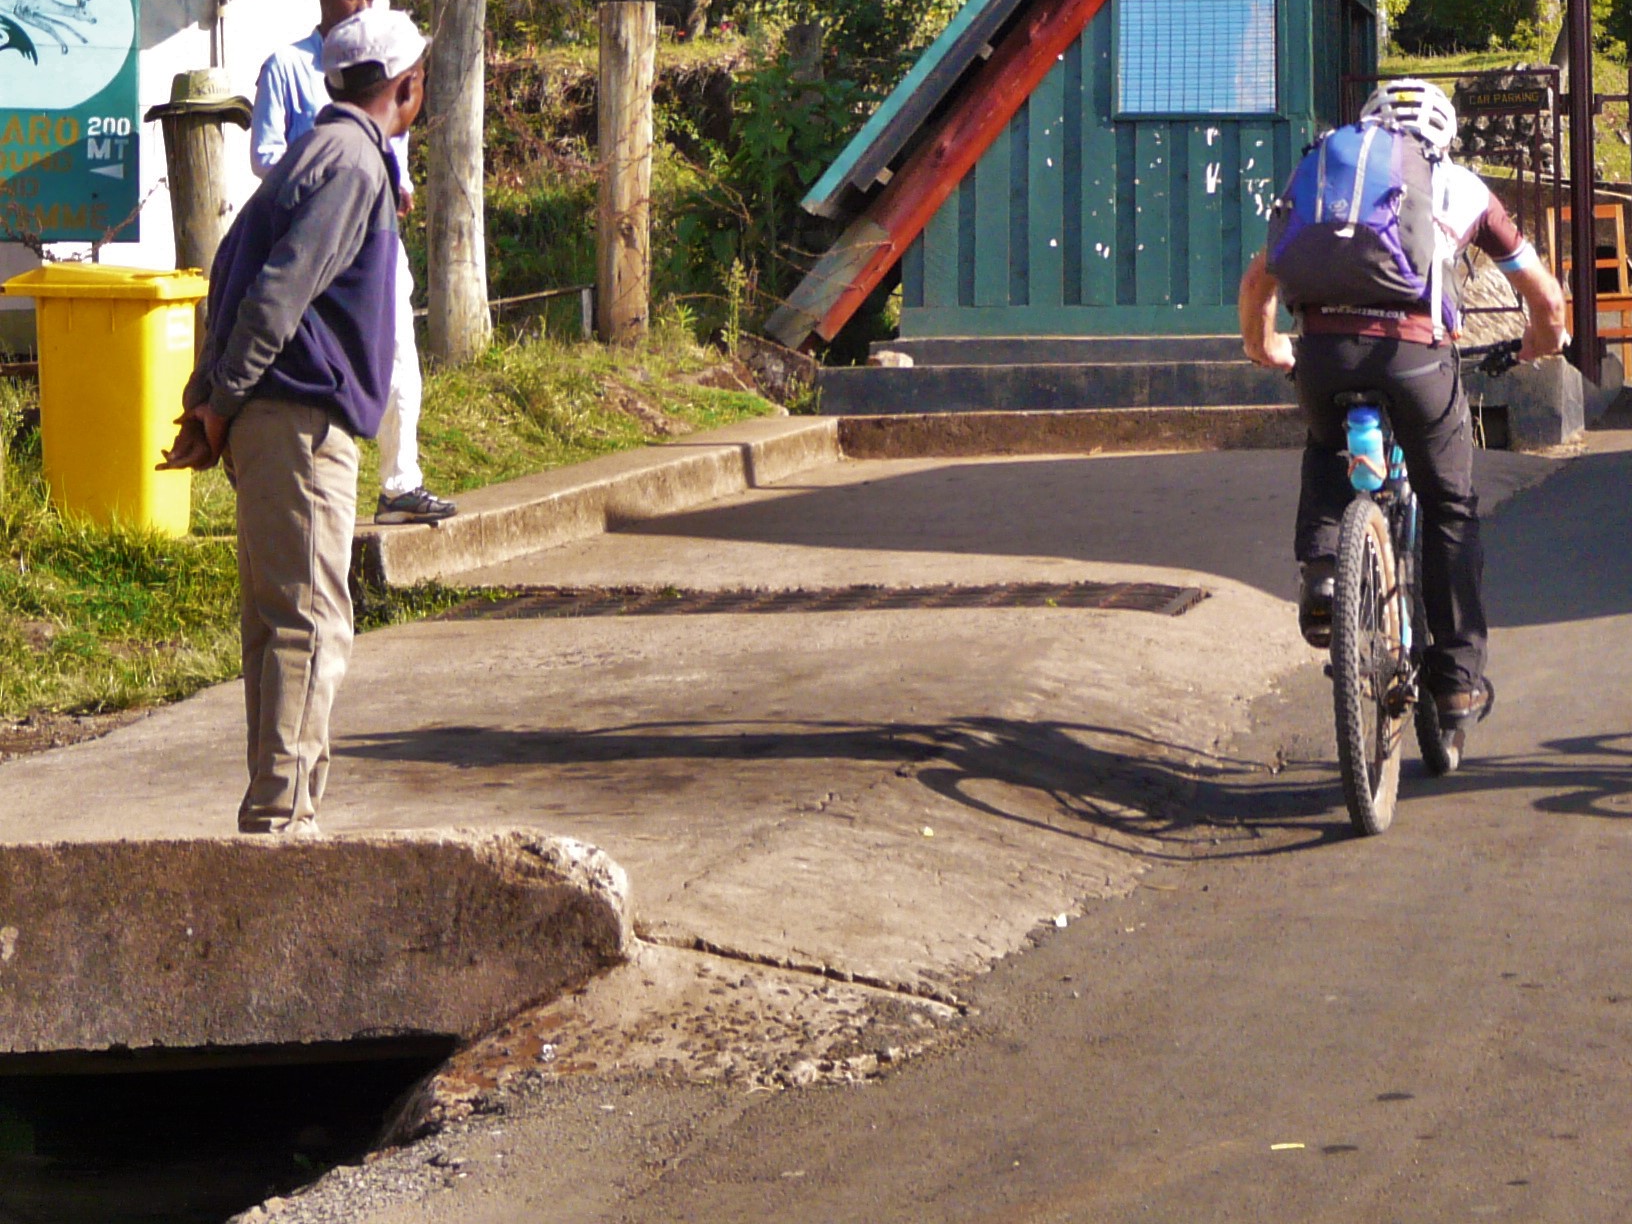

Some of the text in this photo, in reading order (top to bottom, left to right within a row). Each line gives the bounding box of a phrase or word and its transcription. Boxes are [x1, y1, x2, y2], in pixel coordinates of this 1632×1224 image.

[1469, 91, 1539, 105] CAR PARKING
[87, 116, 131, 137] 200
[87, 138, 129, 160] MT
